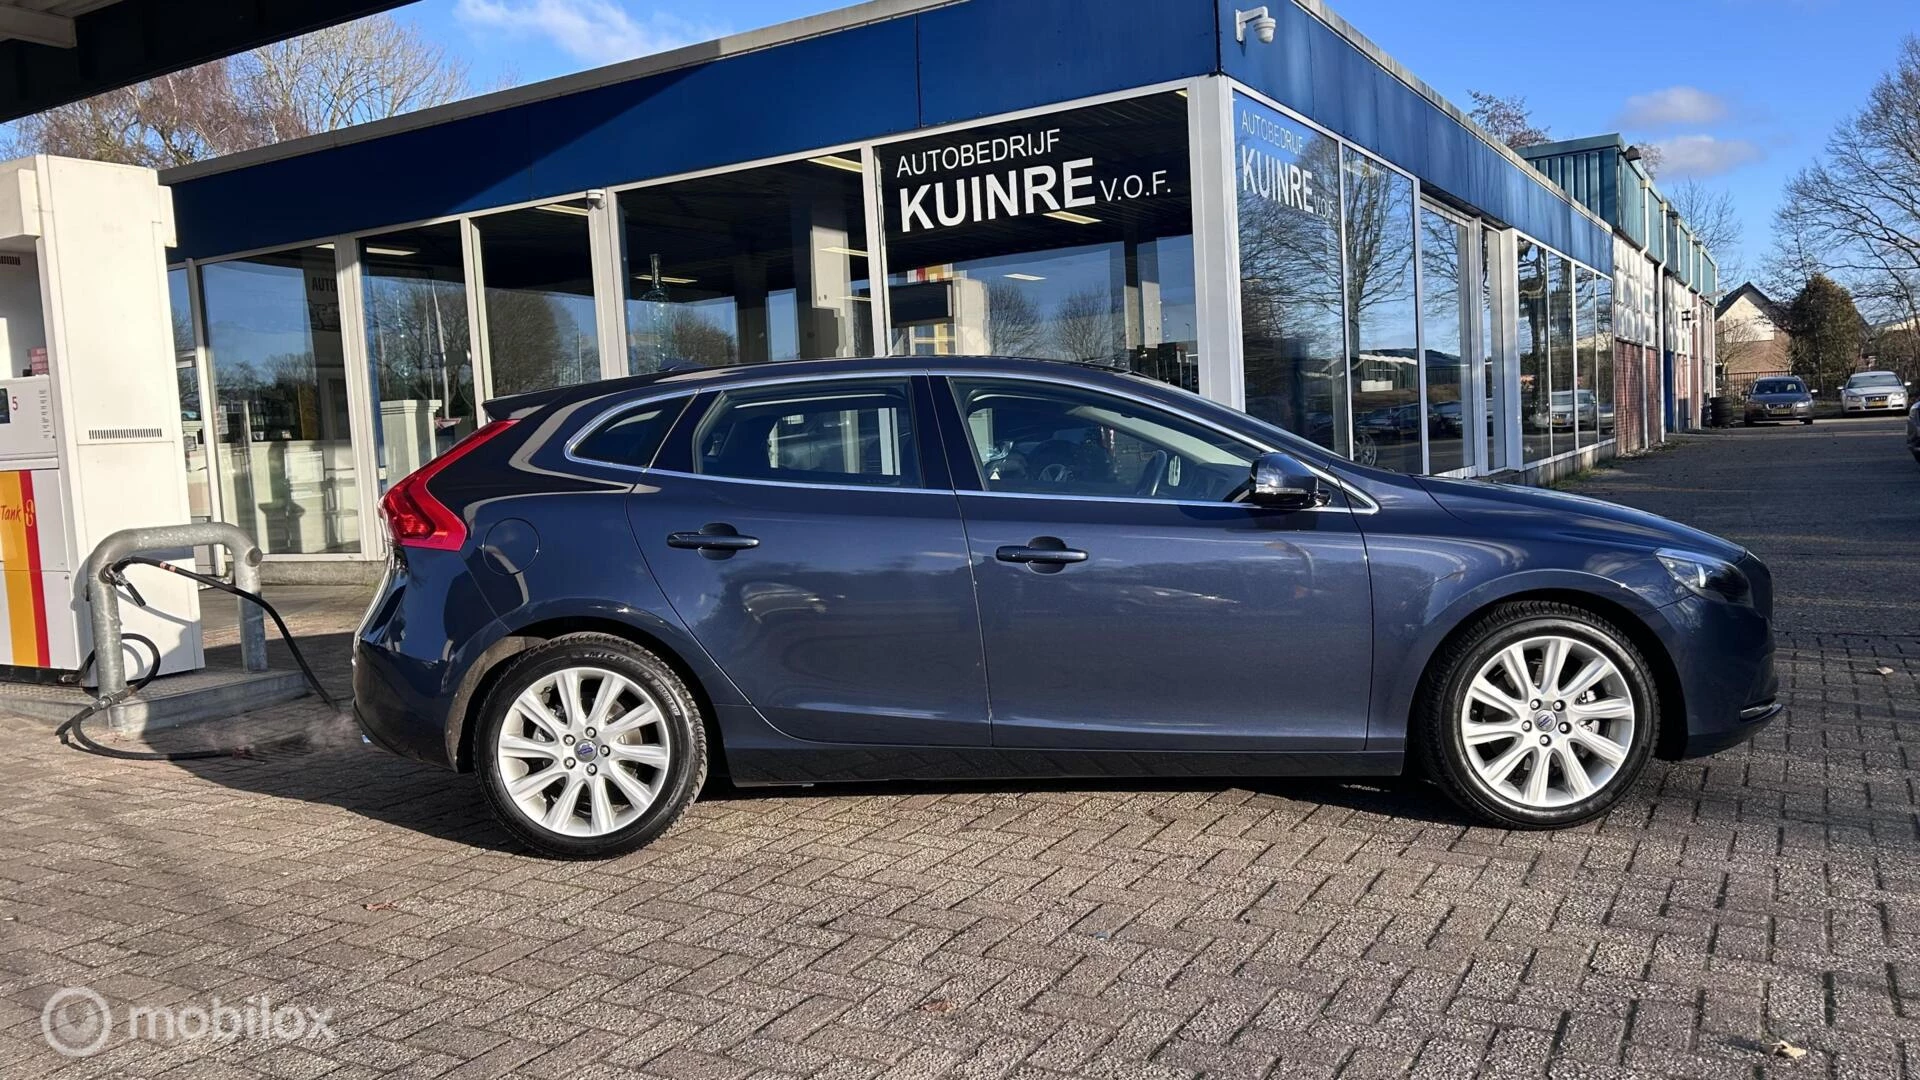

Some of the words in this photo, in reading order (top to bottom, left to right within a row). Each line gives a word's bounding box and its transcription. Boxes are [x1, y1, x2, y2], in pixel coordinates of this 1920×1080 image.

[896, 128, 1061, 178] AUTOBEDRIJF
[1241, 109, 1303, 155] AUTOBEDRIJF
[899, 157, 1096, 233] KUINRE
[1100, 170, 1172, 203] V.O.F.
[1241, 141, 1313, 213] KUINRE
